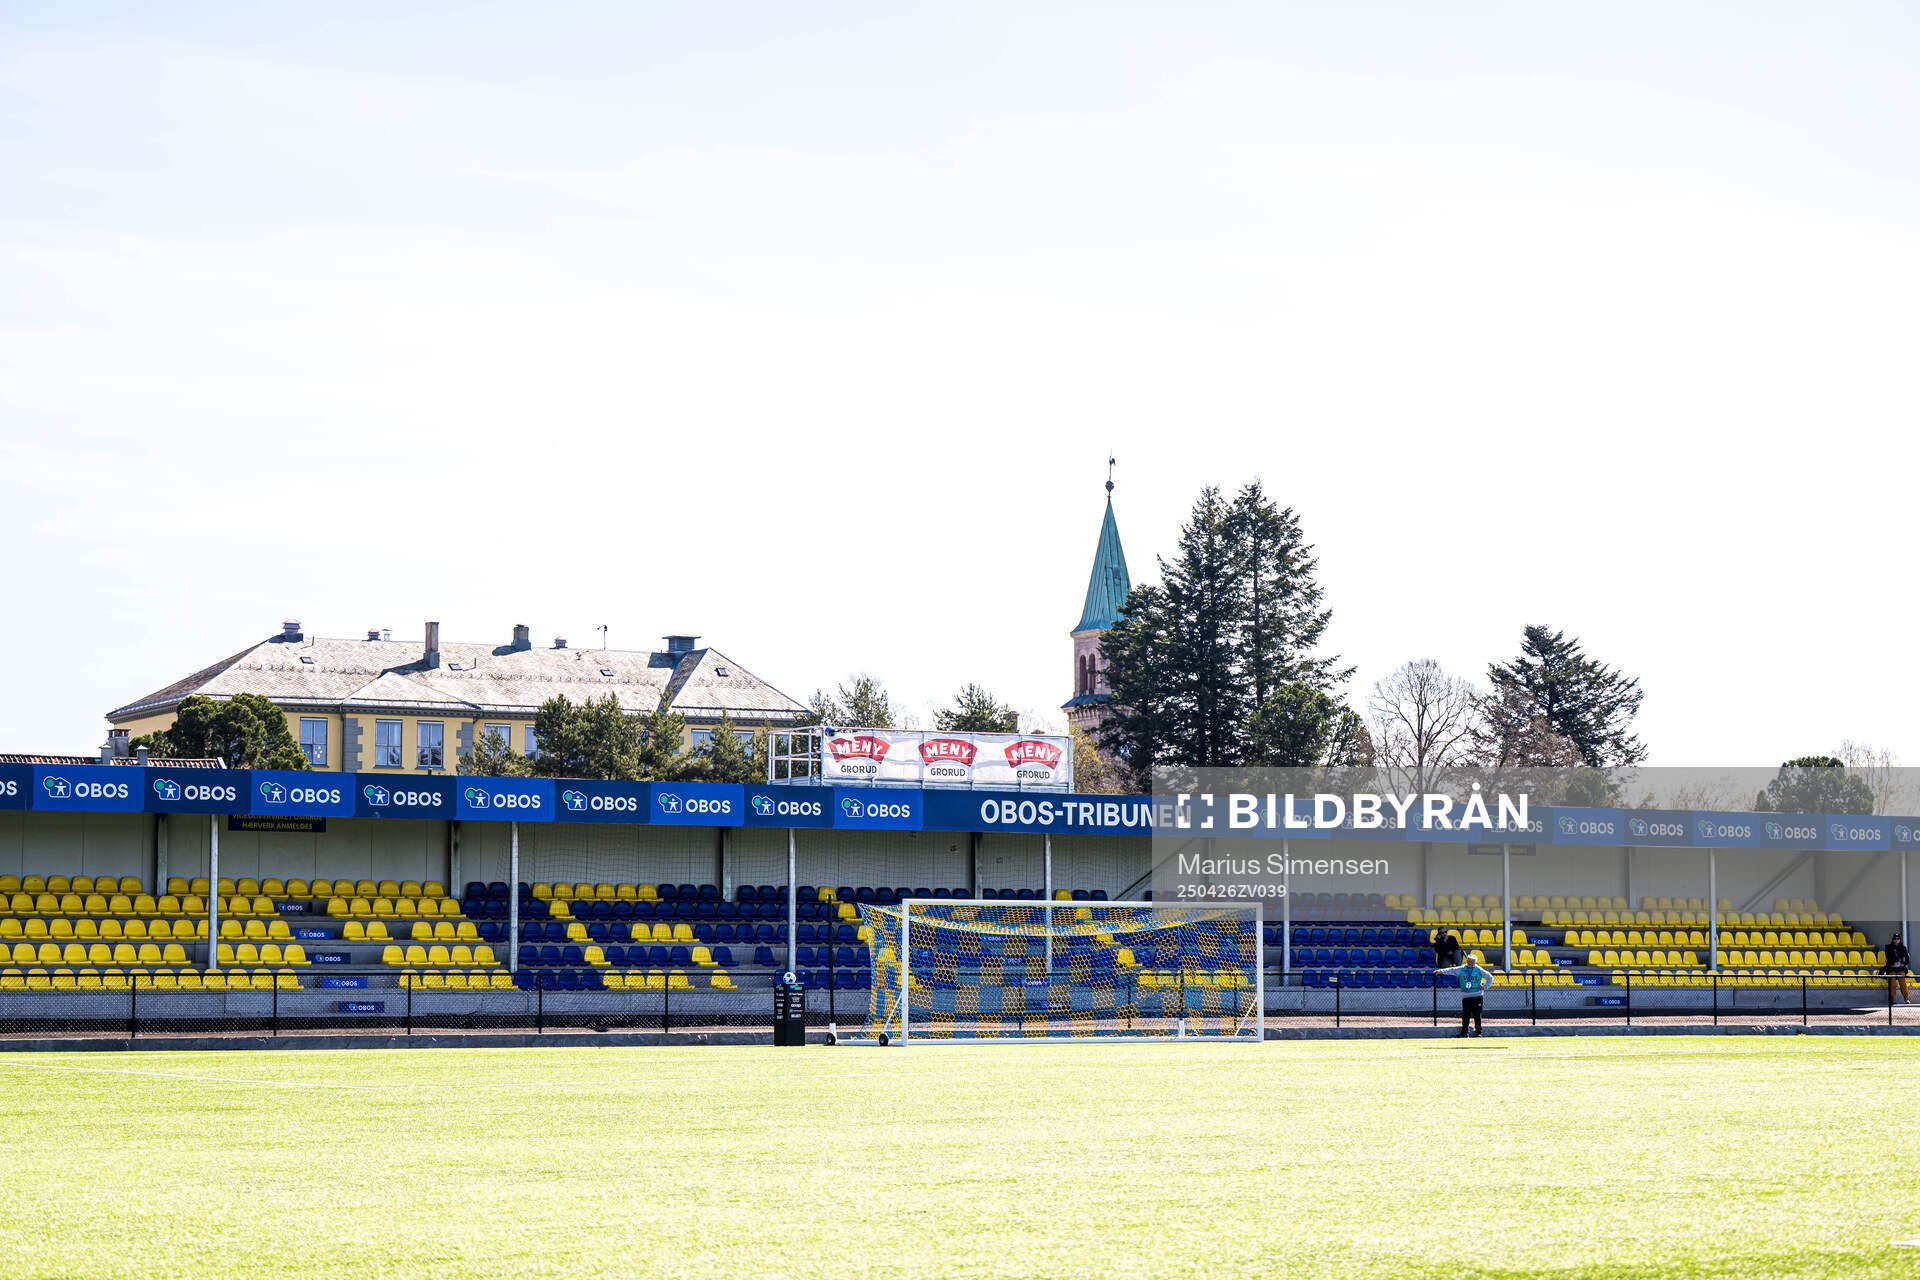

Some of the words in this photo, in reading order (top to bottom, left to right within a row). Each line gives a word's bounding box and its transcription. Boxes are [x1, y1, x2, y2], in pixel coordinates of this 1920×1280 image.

[835, 739, 883, 755] MENY
[925, 742, 971, 758] MENY
[1009, 745, 1057, 761] MENY
[840, 764, 878, 774] GRORUD
[930, 767, 966, 777] GRORUD
[1016, 769, 1050, 779] GRORUD
[75, 782, 129, 798] OBOS
[184, 784, 237, 801] OBOS
[290, 788, 341, 804] OBOS
[393, 791, 442, 807] OBOS
[493, 793, 541, 809] OBOS
[590, 796, 638, 812] OBOS
[685, 798, 732, 814] OBOS
[777, 801, 822, 816] OBOS
[866, 803, 911, 818] OBOS
[980, 799, 1192, 828] OBOS-TRIBUNEN
[1579, 821, 1614, 835] OBOS
[1649, 823, 1684, 837] OBOS
[1718, 825, 1751, 838] OBOS
[1784, 827, 1817, 840] OBOS
[1849, 828, 1882, 841] OBOS
